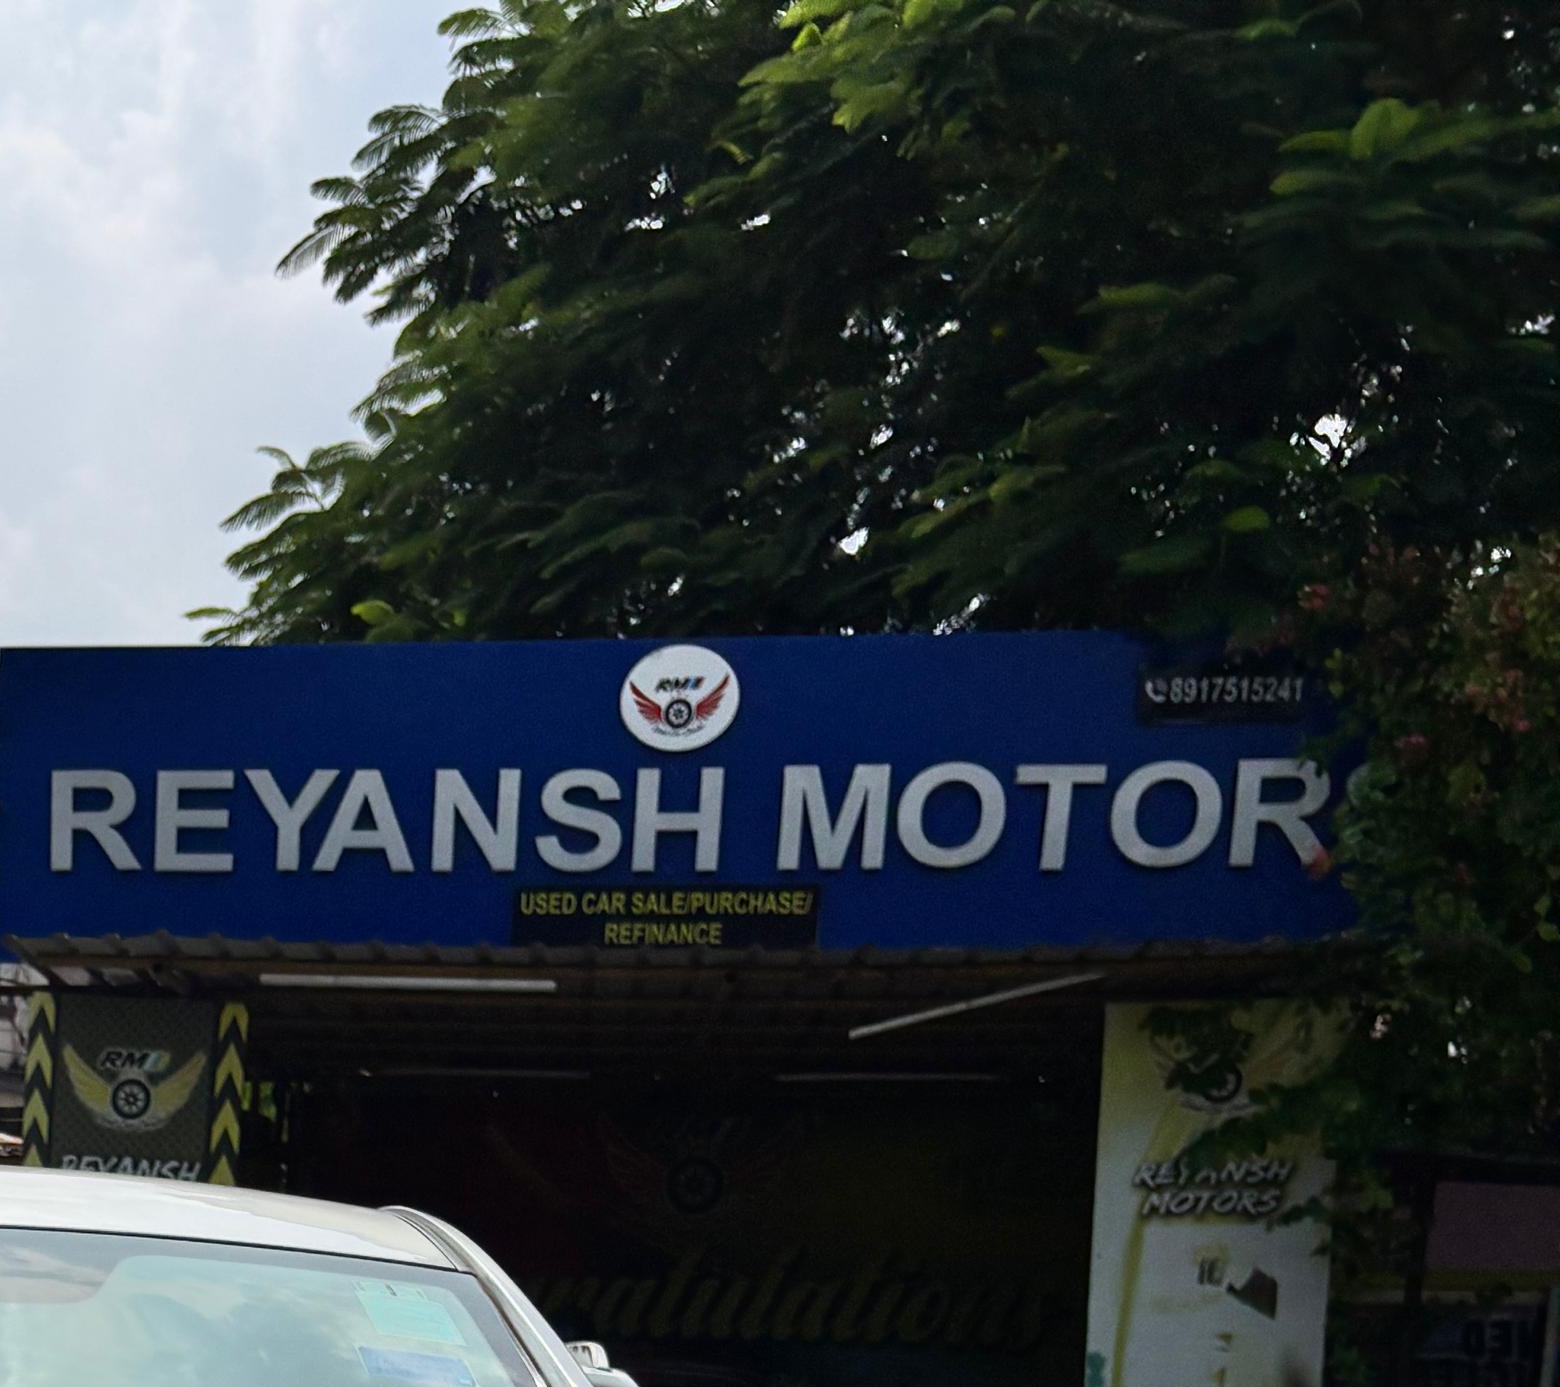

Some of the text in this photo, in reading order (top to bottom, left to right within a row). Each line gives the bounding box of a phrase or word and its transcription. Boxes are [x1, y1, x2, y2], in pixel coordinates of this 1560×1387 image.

[1170, 677, 1304, 703] 8917515241
[50, 757, 1378, 874] REYANSH MOTOR
[520, 892, 578, 915] USED
[582, 892, 626, 915] CAR
[604, 922, 723, 945] REFINANCE
[1142, 1188, 1282, 1216] MOTORS
